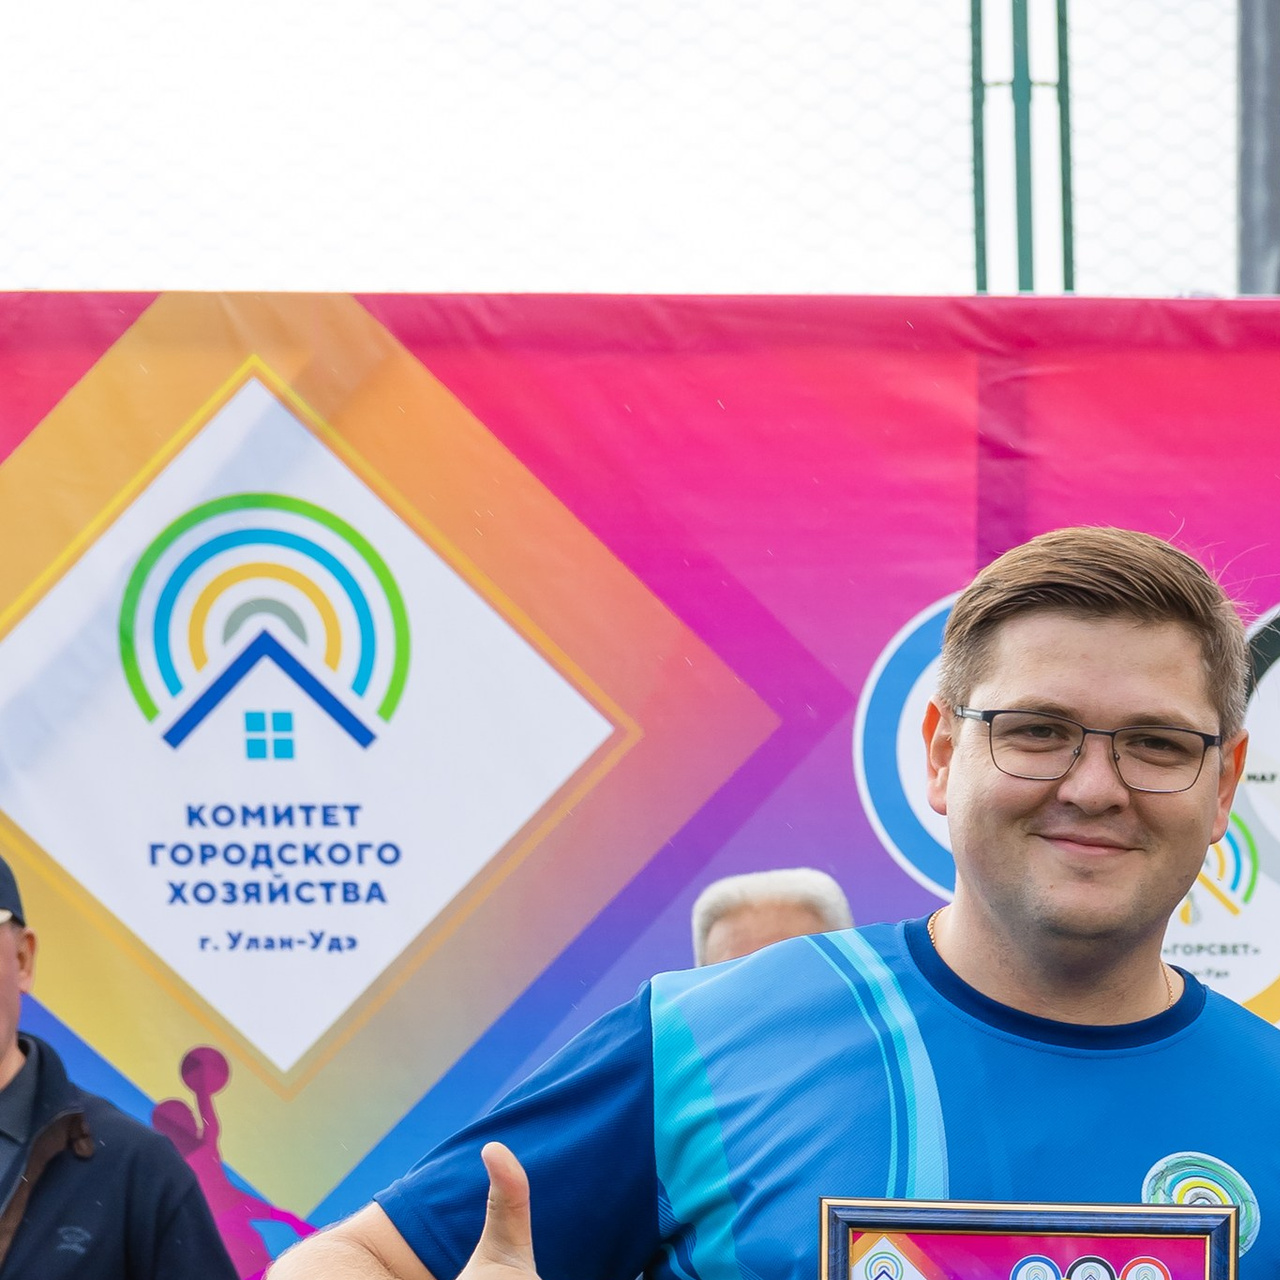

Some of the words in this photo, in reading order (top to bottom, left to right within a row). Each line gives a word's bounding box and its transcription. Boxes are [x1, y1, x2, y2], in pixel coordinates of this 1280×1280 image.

[186, 804, 361, 828] КОМИТЕТ
[149, 842, 401, 870] ГОРОДСКОГО
[167, 873, 388, 904] ХОЗЯЙСТВА
[200, 936, 220, 951] г.
[227, 931, 357, 952] Улан-Удэ
